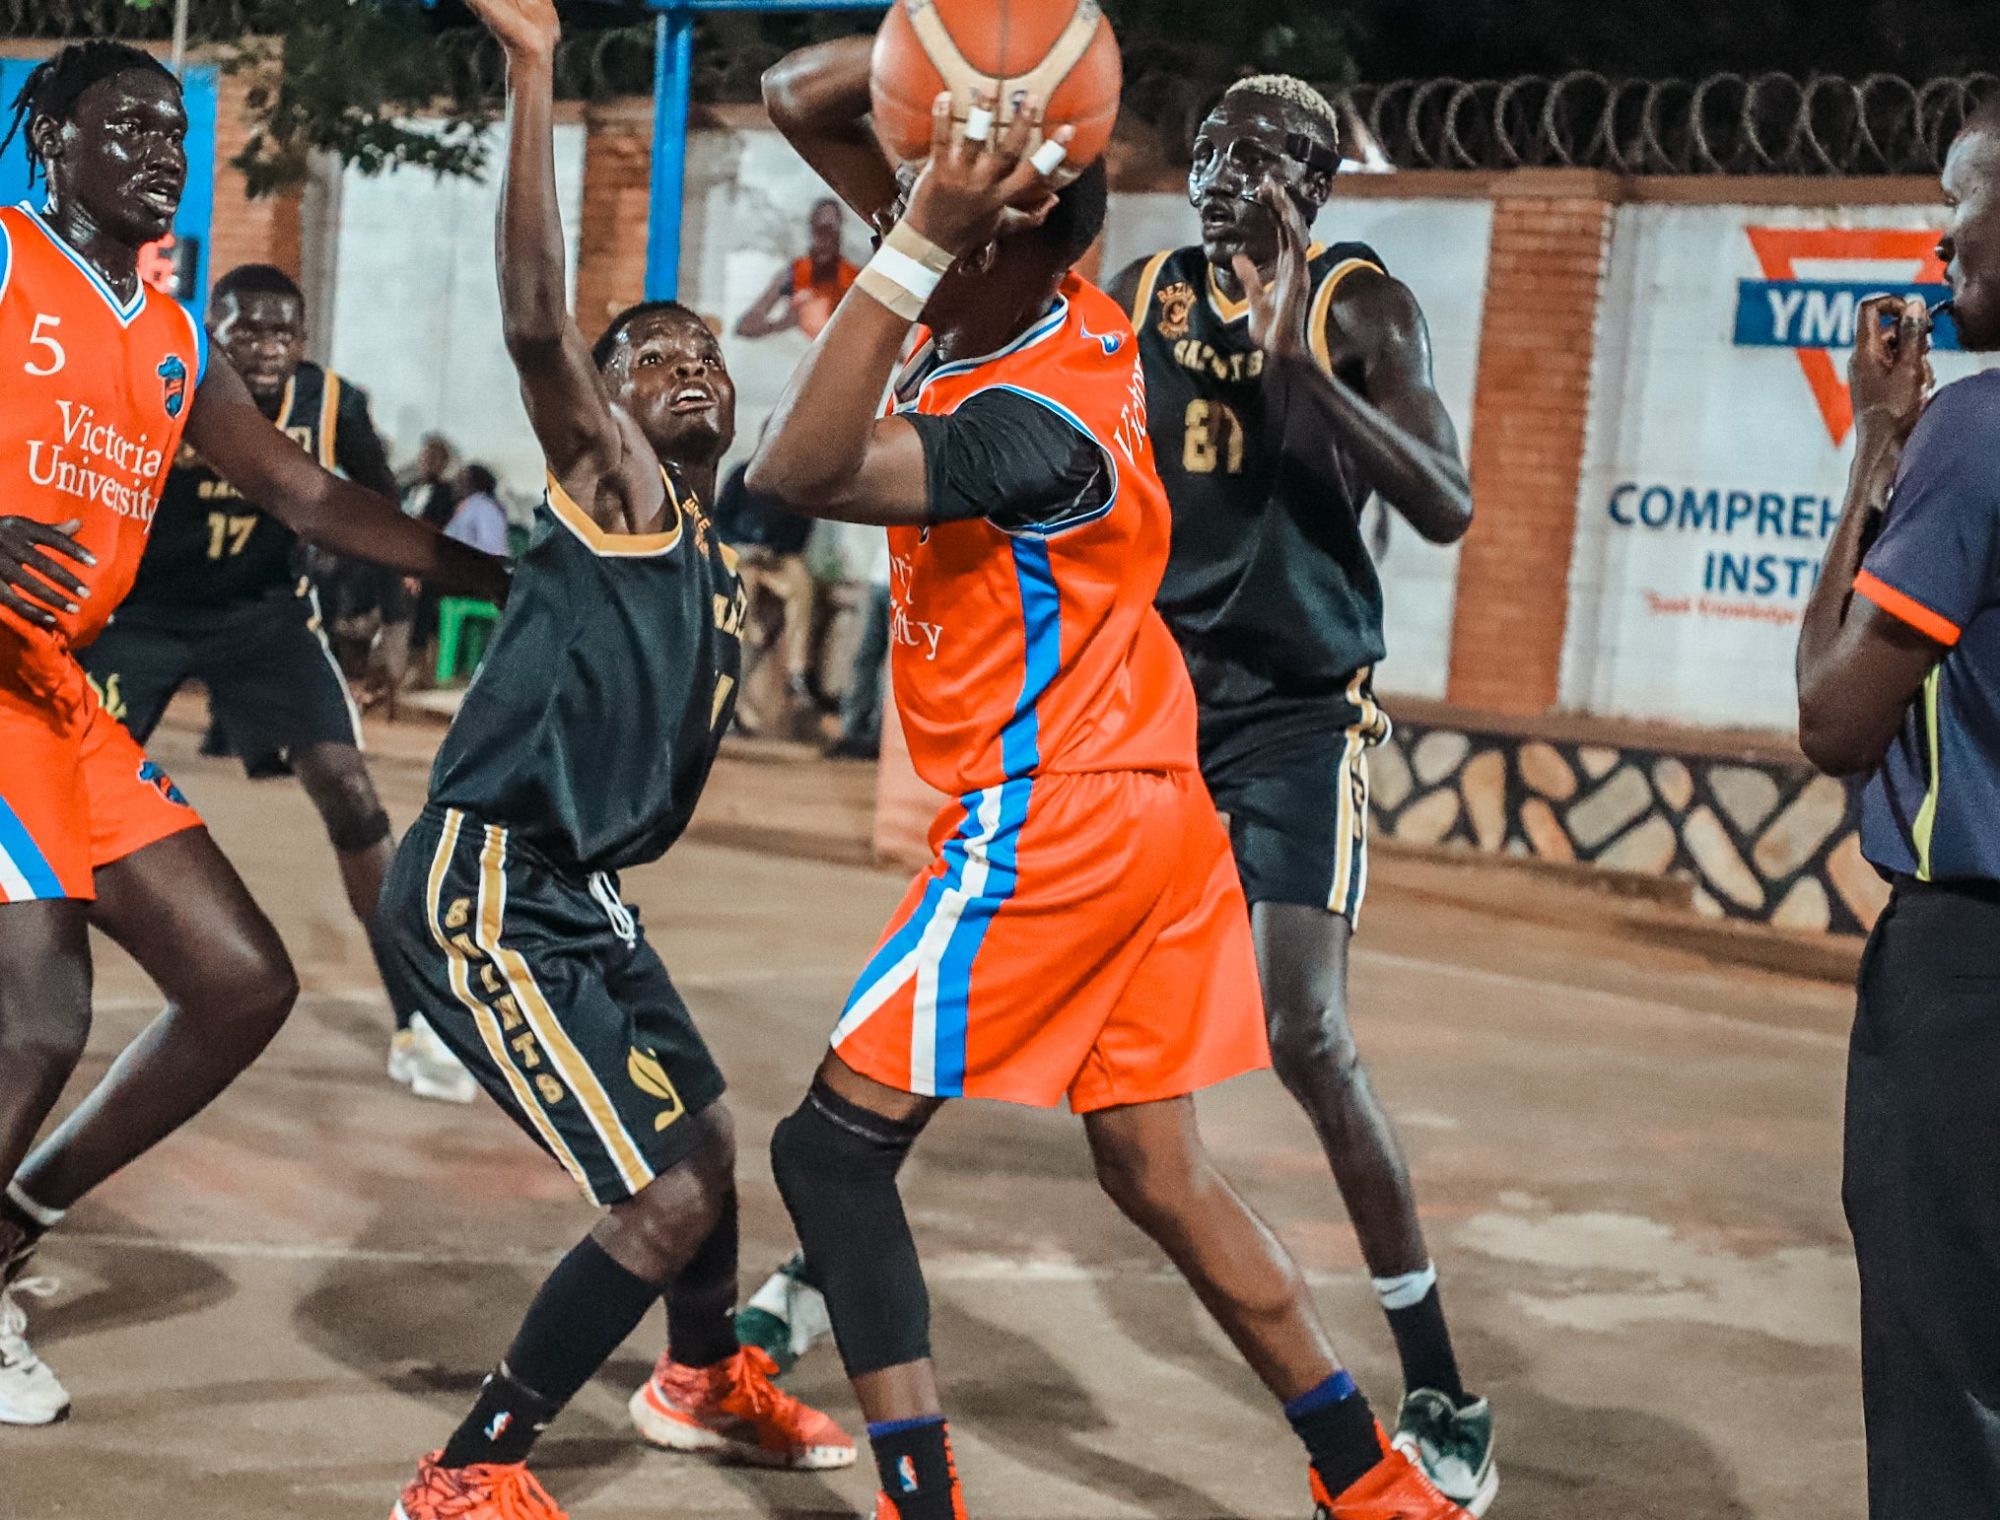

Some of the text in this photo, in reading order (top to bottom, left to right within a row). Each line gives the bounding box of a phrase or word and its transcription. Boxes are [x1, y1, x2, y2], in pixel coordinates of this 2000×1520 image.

[24, 313, 66, 376] 5
[1767, 289, 1933, 345] YM
[207, 511, 258, 560] 17
